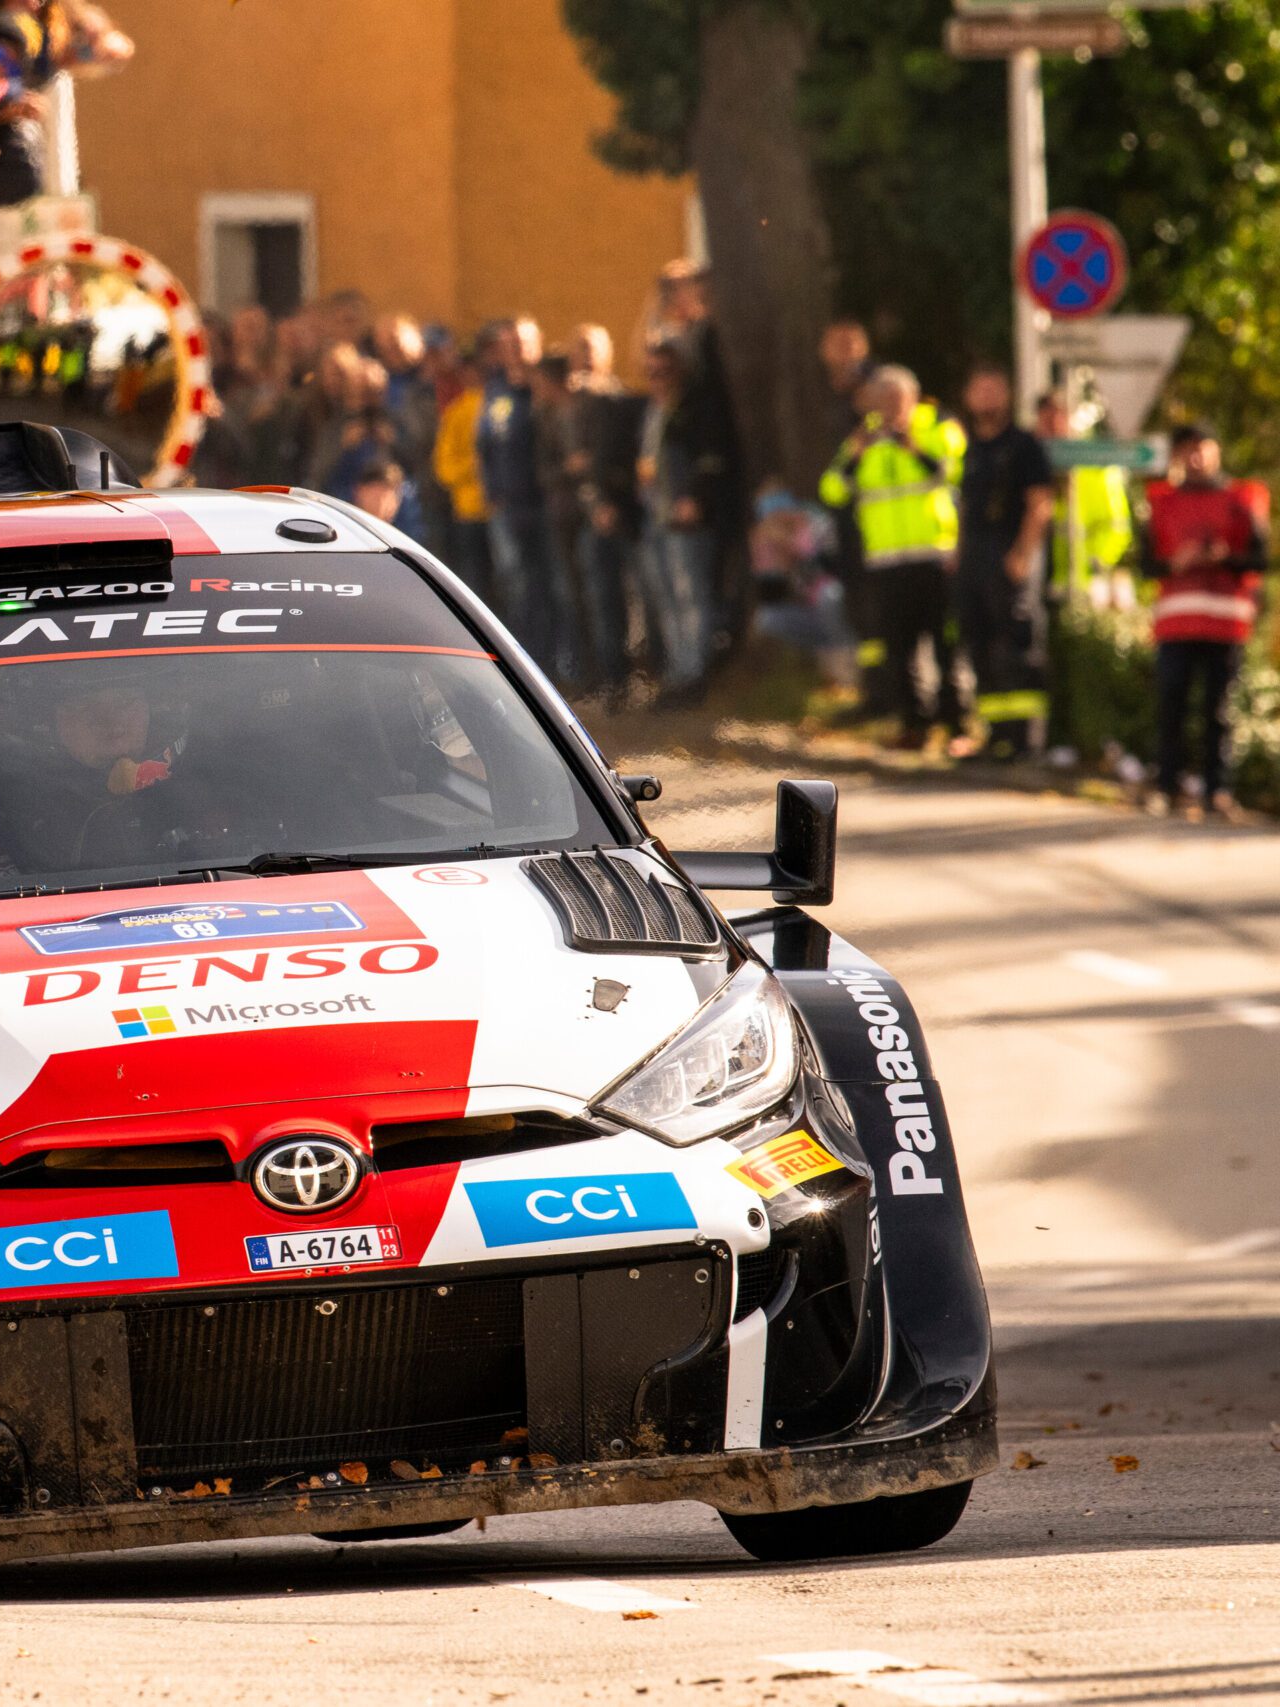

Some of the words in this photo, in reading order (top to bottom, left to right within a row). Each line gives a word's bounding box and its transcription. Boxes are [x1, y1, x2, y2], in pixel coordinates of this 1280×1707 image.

[189, 578, 364, 597] Racing
[172, 921, 219, 939] 69
[22, 941, 440, 1008] DENSO
[183, 993, 377, 1025] Microsoft
[825, 968, 944, 1196] Panasonic
[738, 1137, 832, 1190] PIRELLI
[255, 1257, 269, 1266] FIN
[279, 1233, 373, 1264] A-6764
[378, 1228, 394, 1240] 11
[382, 1244, 398, 1257] 23
